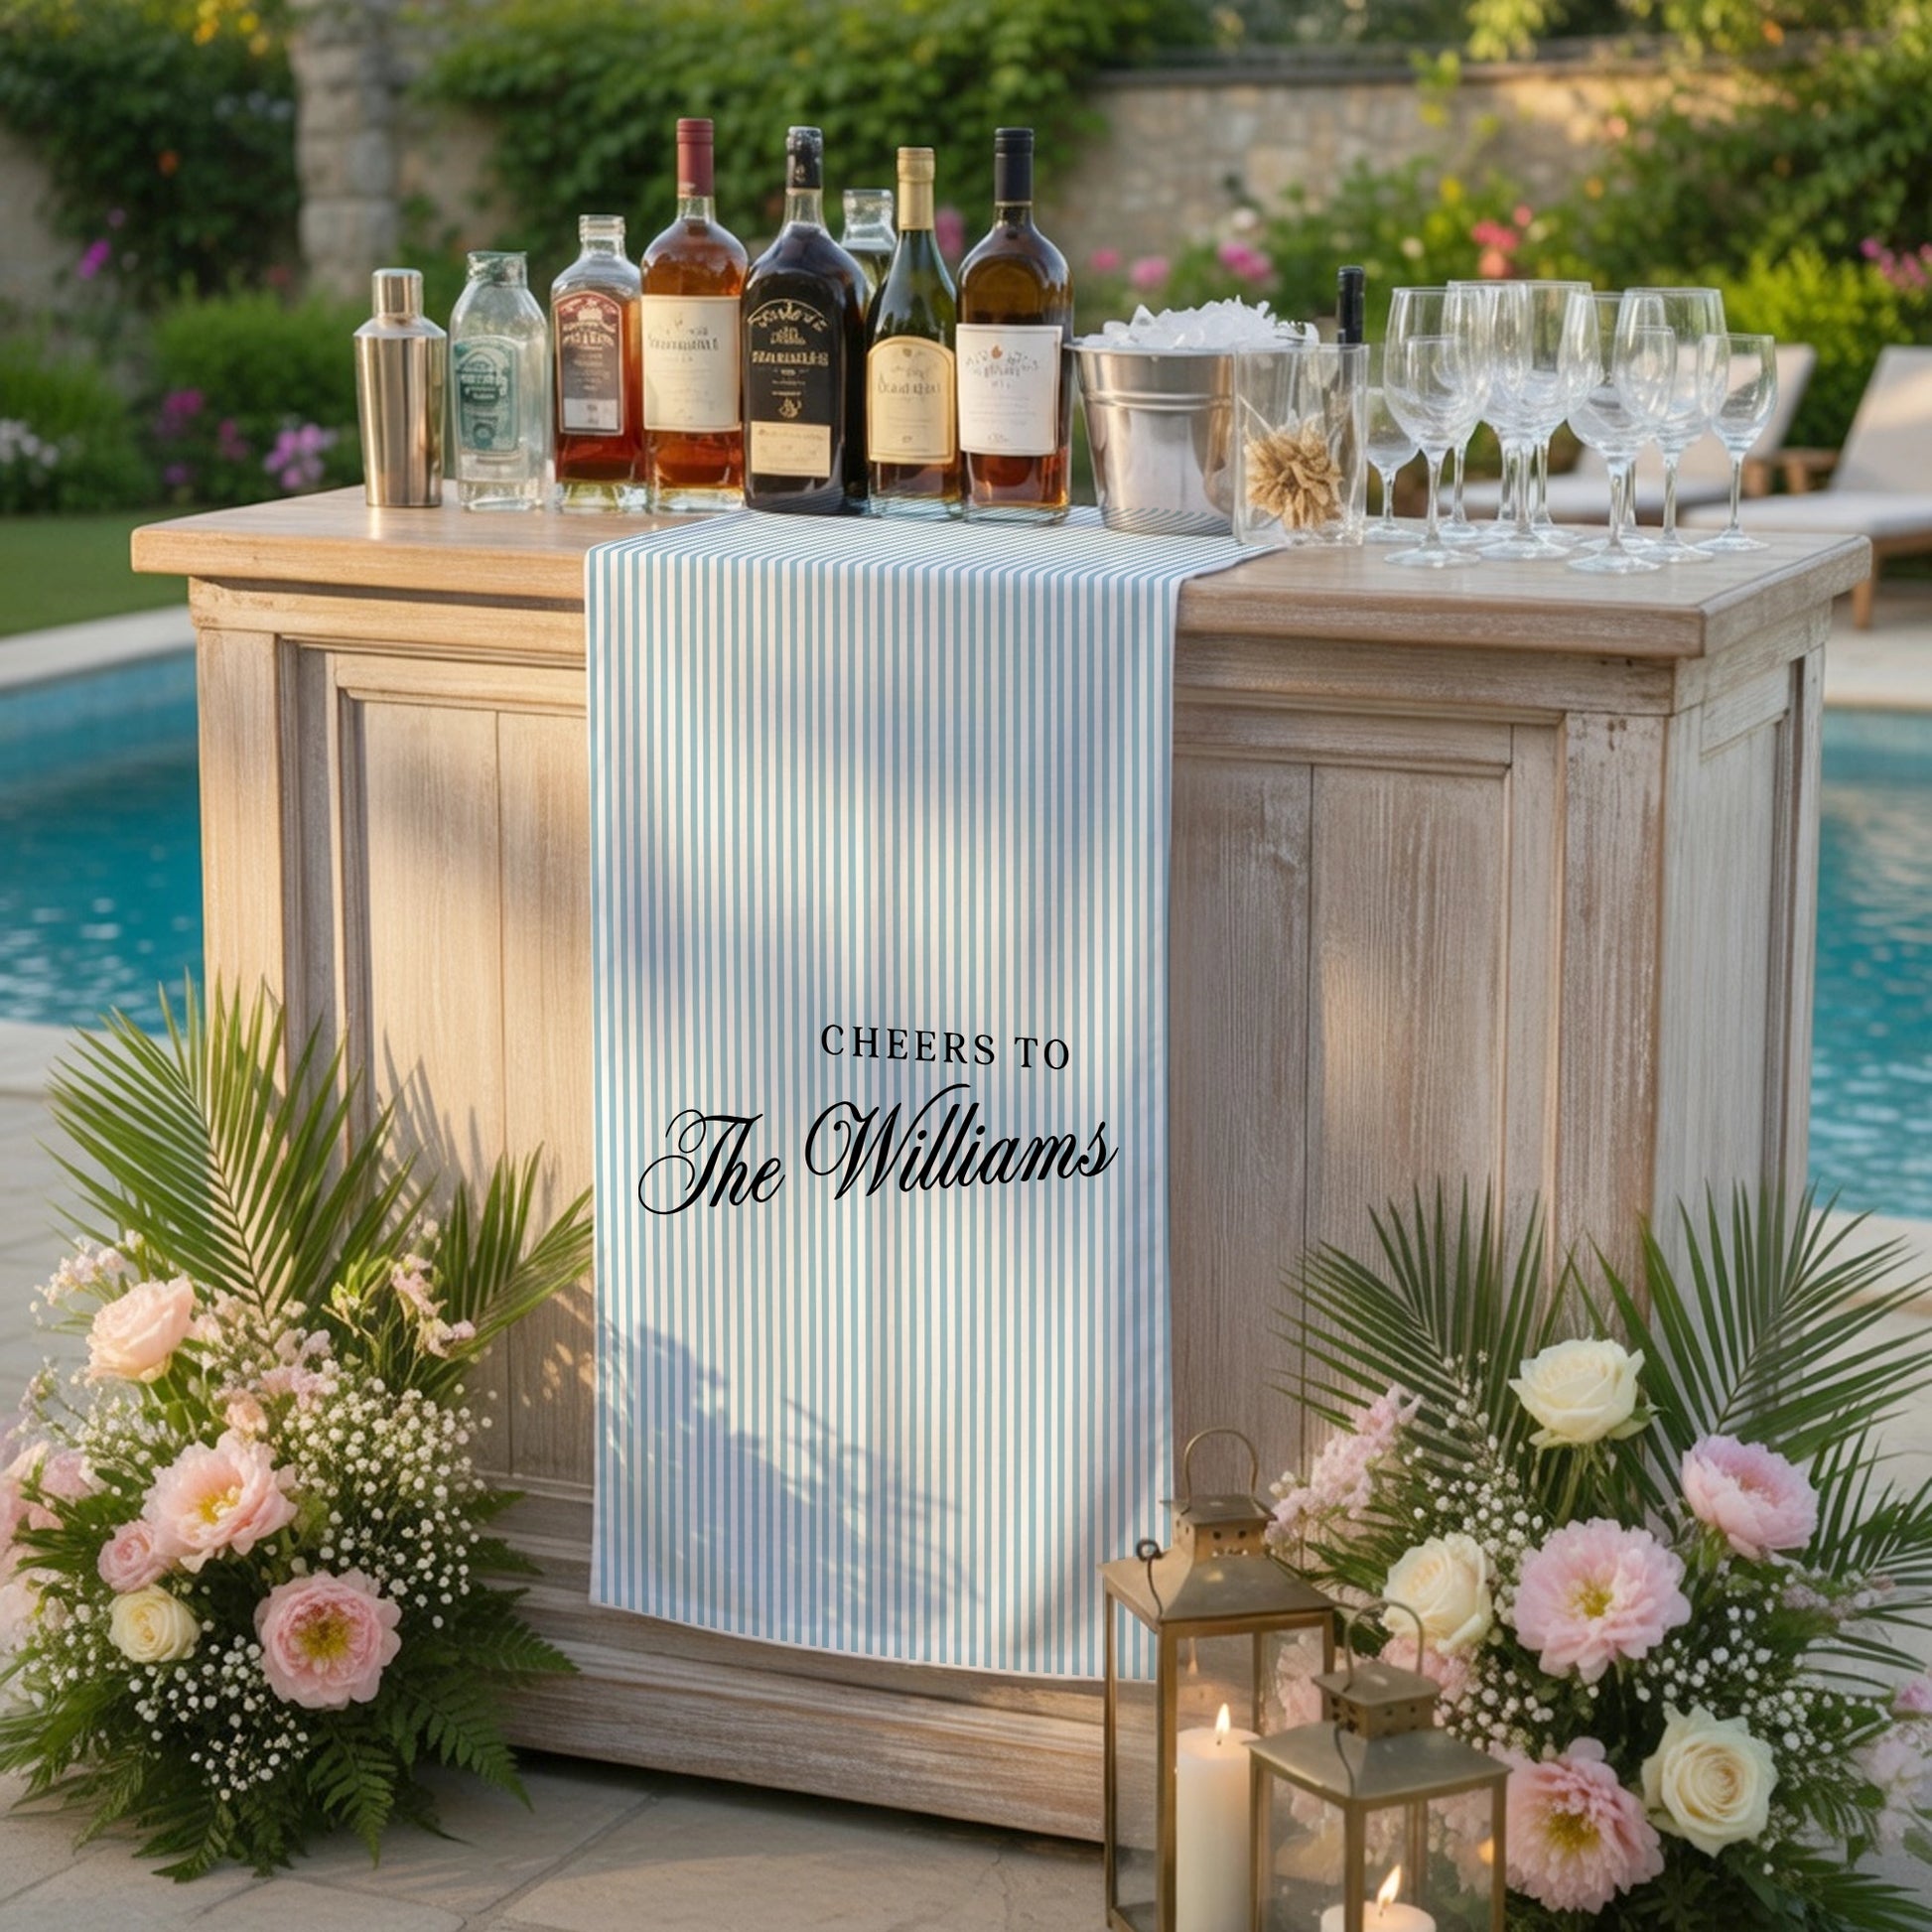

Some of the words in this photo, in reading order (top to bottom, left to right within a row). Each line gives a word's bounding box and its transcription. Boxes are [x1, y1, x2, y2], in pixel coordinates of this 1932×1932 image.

[821, 1024, 995, 1065] CHEERS
[1014, 1036, 1069, 1070] TO
[637, 1109, 786, 1215] The
[804, 1083, 1120, 1200] Williams
